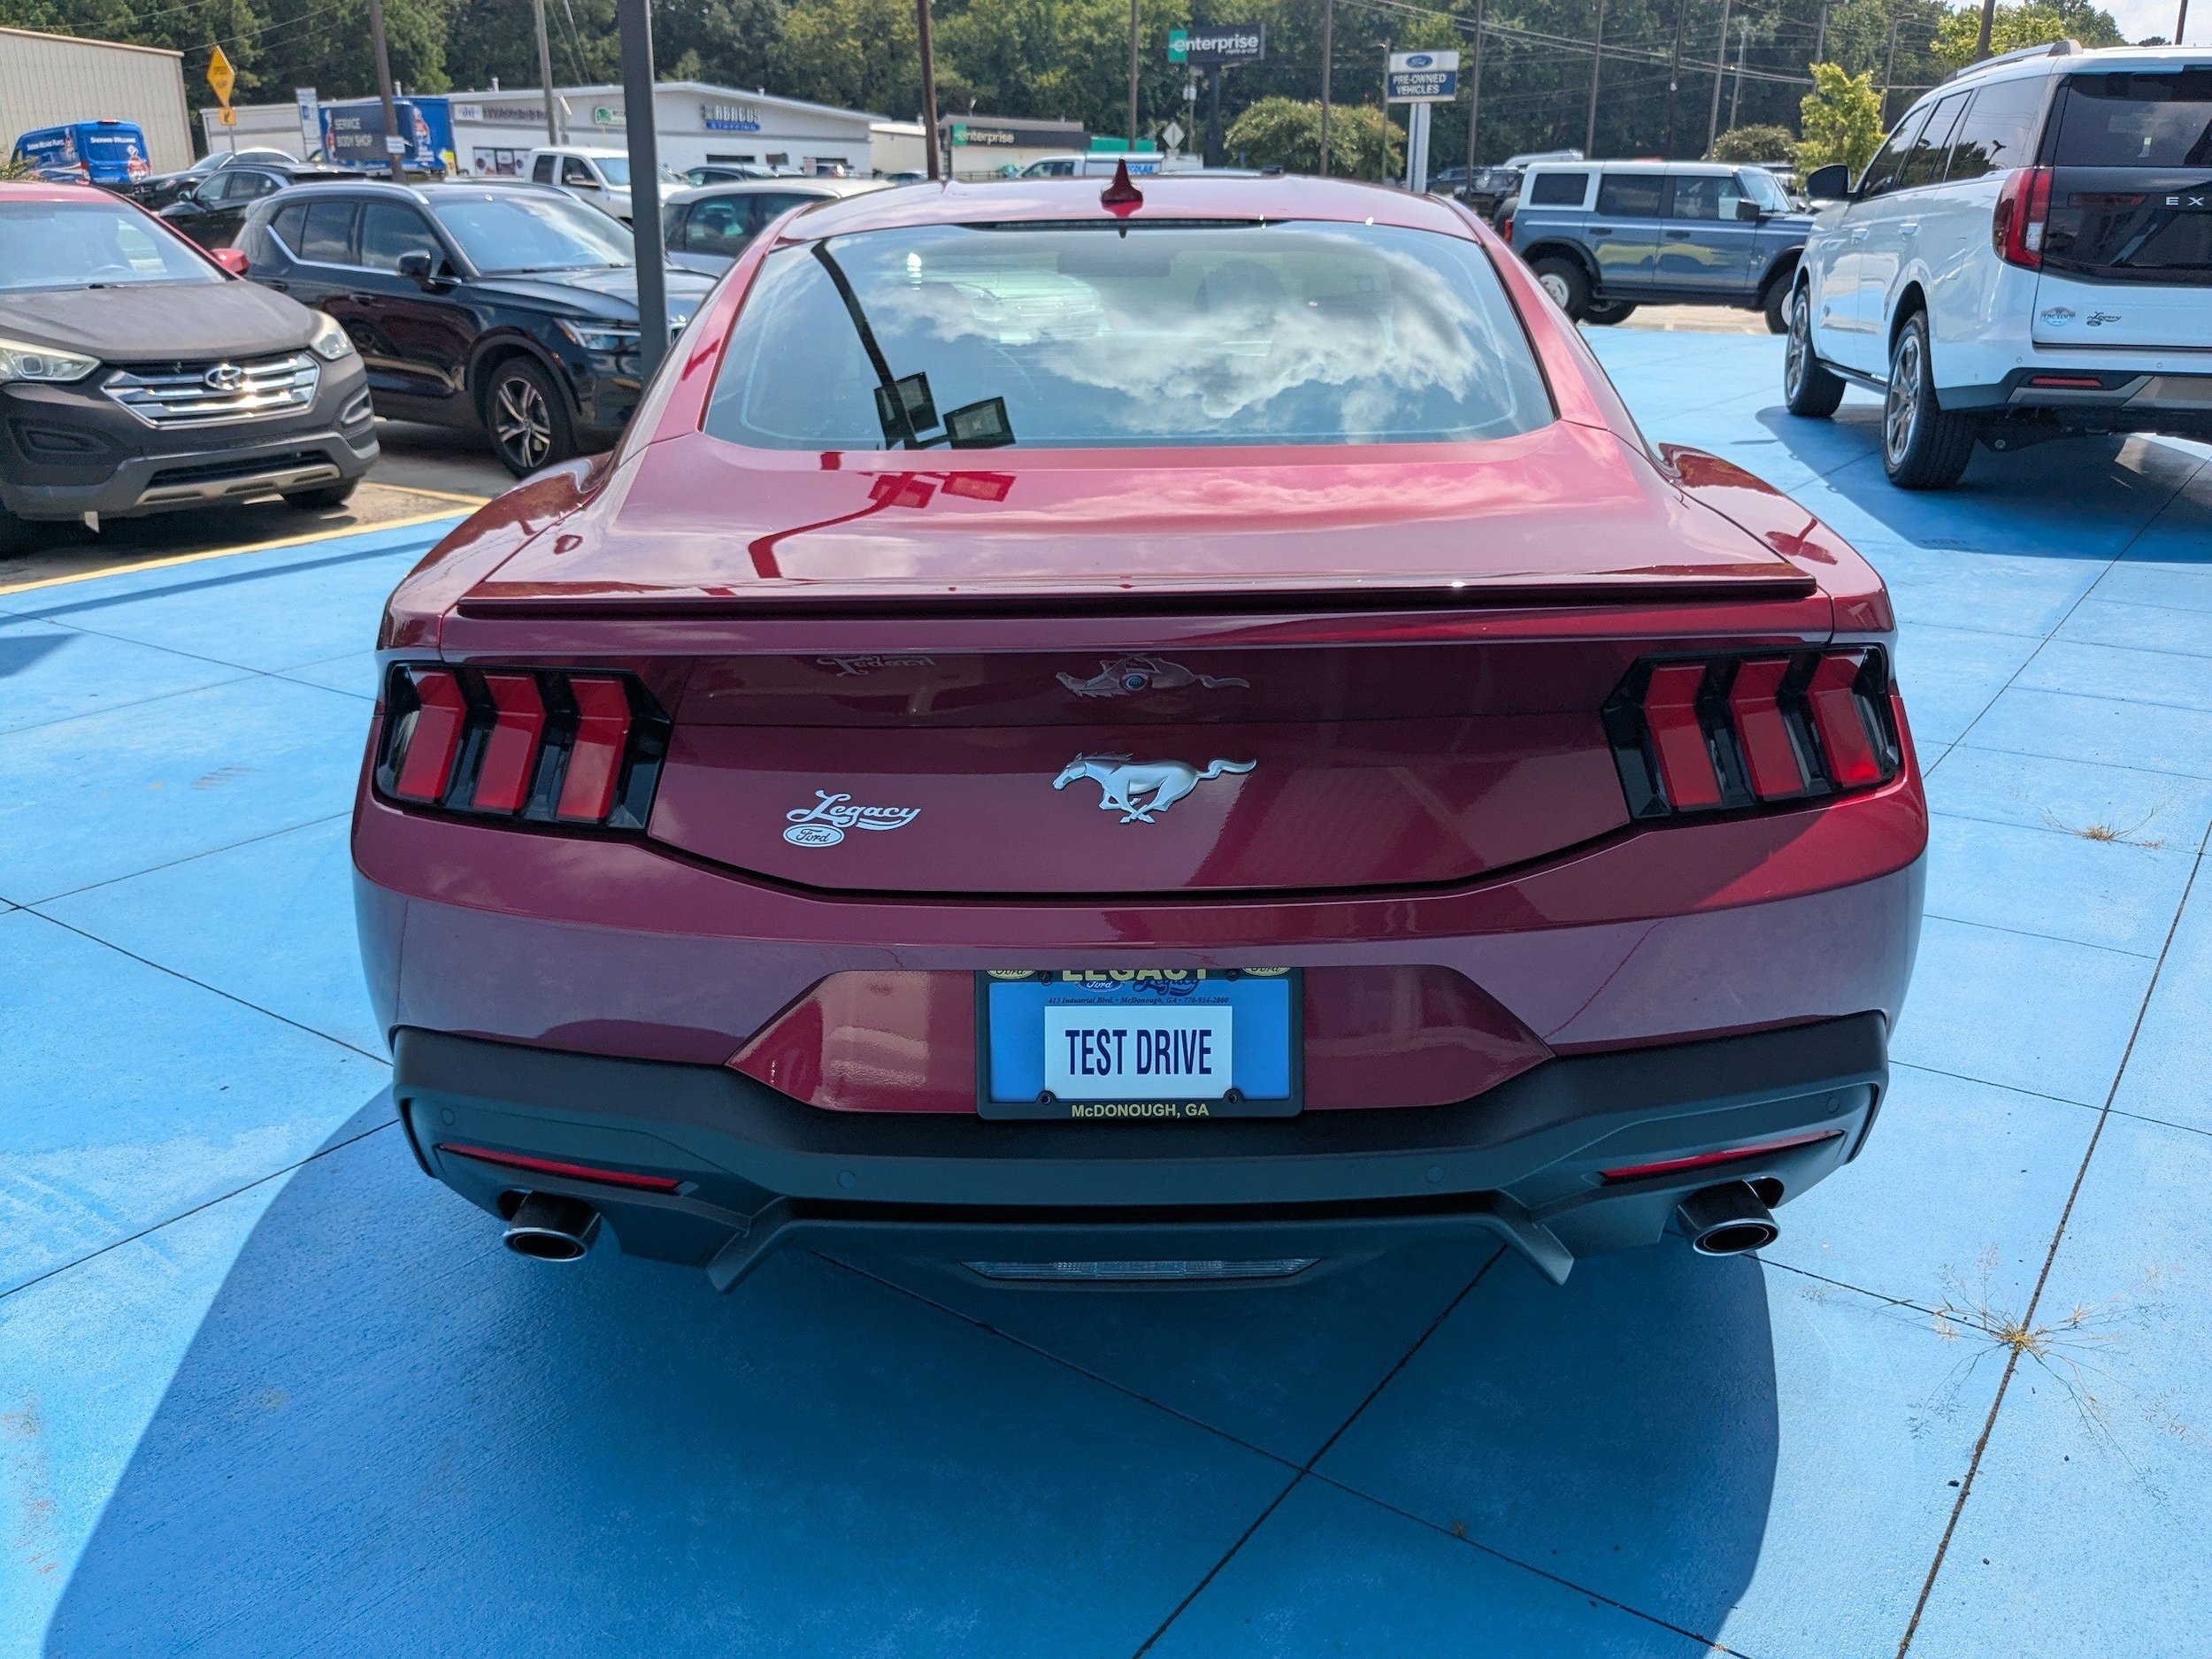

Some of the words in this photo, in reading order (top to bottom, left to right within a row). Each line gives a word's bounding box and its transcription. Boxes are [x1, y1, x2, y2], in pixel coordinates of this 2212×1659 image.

[1173, 35, 1259, 53] enterprise
[1393, 73, 1447, 84] PRE-OWNED
[1396, 84, 1440, 95] VEHICLES
[334, 118, 361, 130] SERVICE
[956, 130, 1015, 145] enterprise
[2086, 311, 2122, 322] Legacy
[786, 790, 922, 831] Legacy
[795, 828, 831, 842] Ford
[1121, 996, 1164, 1005] McDonough,
[1064, 1028, 1127, 1076] TEST
[1136, 1029, 1212, 1075] DRIVE
[1071, 1104, 1181, 1118] McDONOUGH,
[1185, 1103, 1210, 1117] GA
